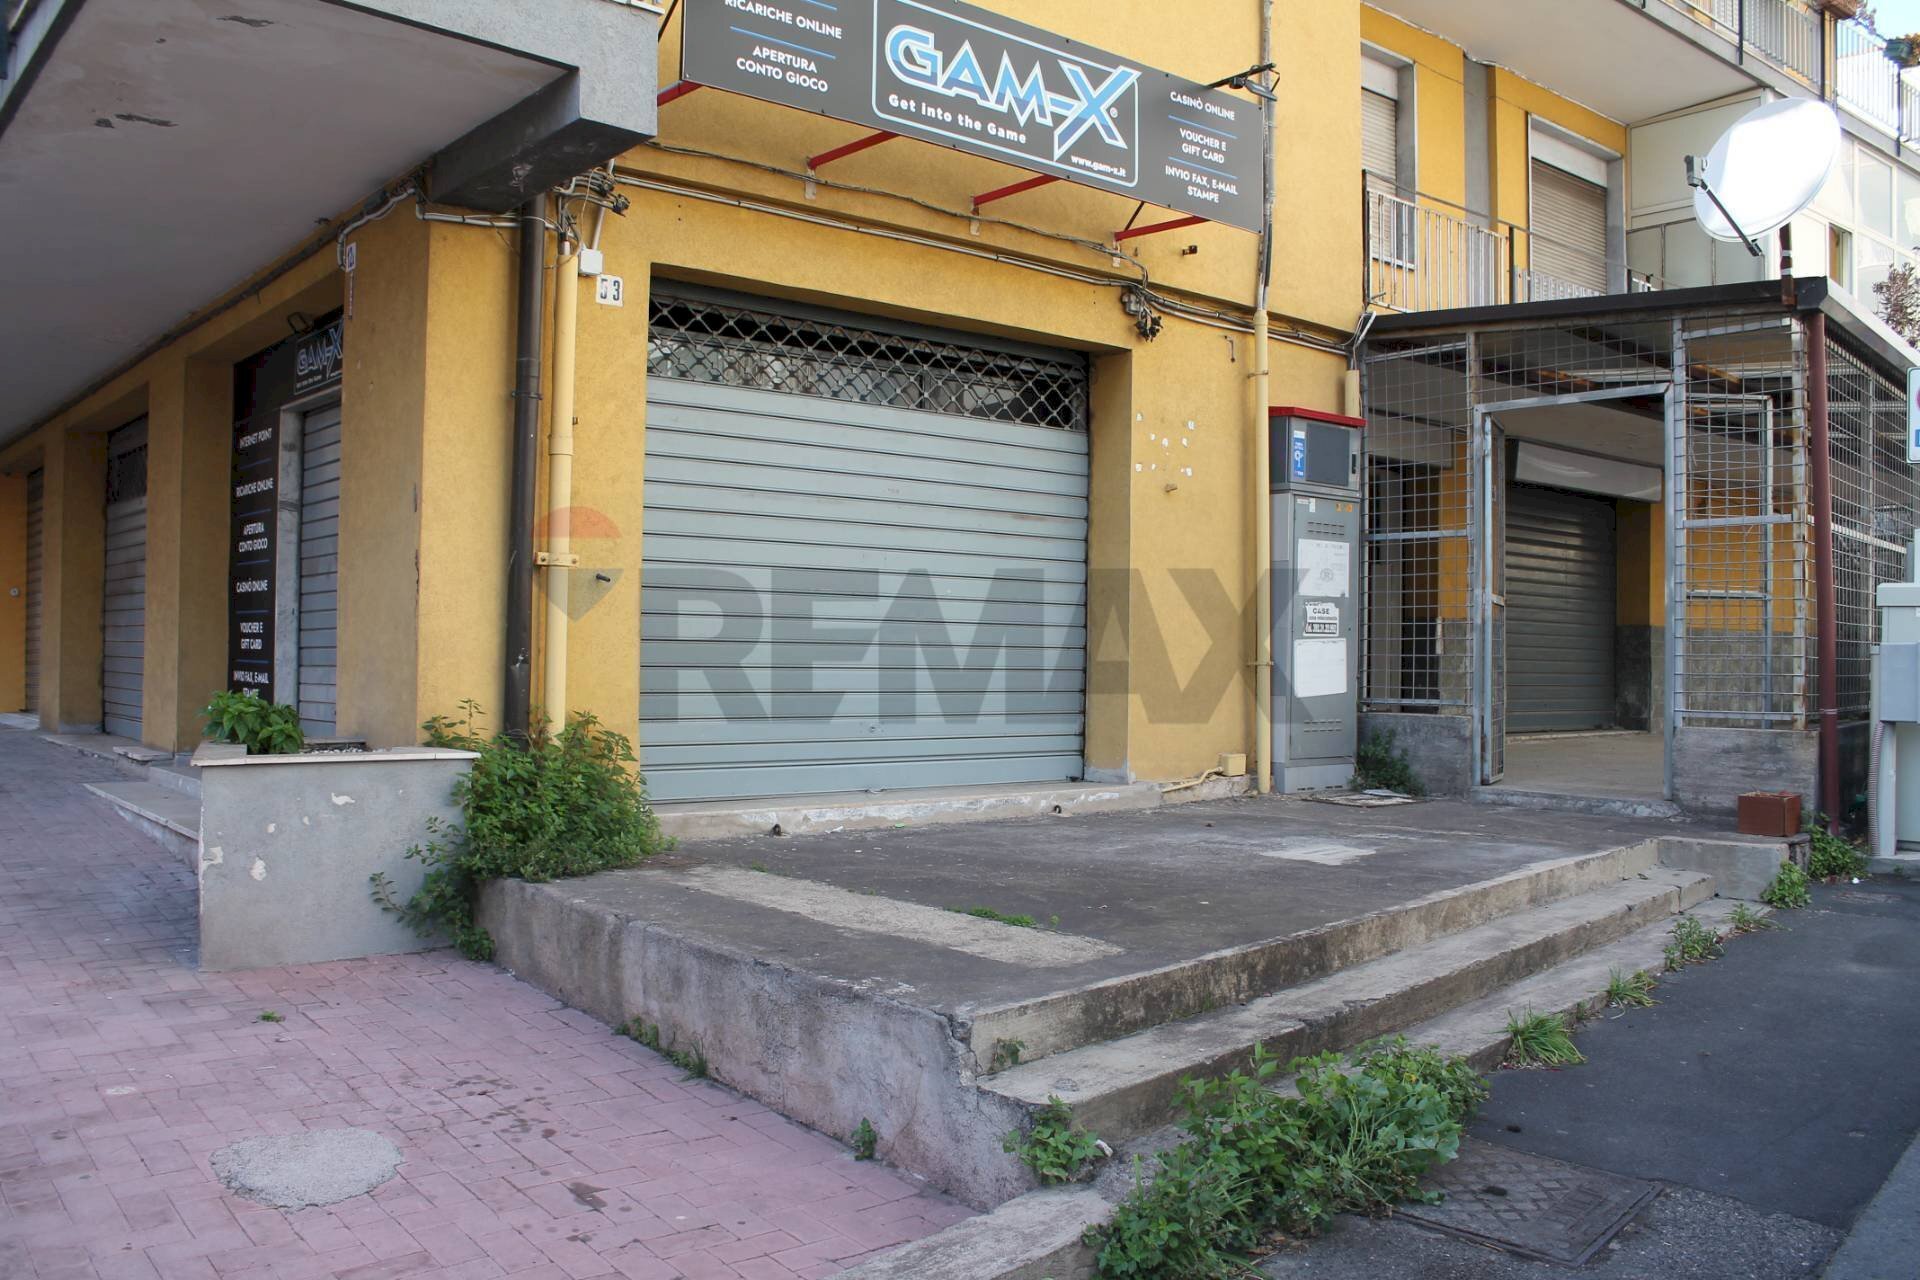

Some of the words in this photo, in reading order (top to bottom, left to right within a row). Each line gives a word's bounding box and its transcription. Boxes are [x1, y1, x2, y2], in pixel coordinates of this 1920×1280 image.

[796, 16, 842, 39] ONLINE
[752, 45, 817, 73] APERTURA
[736, 57, 783, 80] CONTO
[786, 71, 828, 92] GIOCO
[888, 94, 916, 112] Get
[958, 113, 982, 131] the
[987, 122, 1026, 144] Game
[1205, 103, 1235, 121] ONLINE
[1180, 128, 1222, 150] VOUCHER
[1222, 142, 1226, 151] E
[1182, 143, 1200, 157] GIFT
[1202, 149, 1224, 164] CARD
[1165, 165, 1190, 181] INVIO
[1192, 174, 1210, 188] FAX,
[1212, 179, 1238, 195] E-MAIL
[1187, 186, 1219, 203] STAMPE
[600, 278, 620, 301] 53
[1312, 607, 1329, 615] CASE
